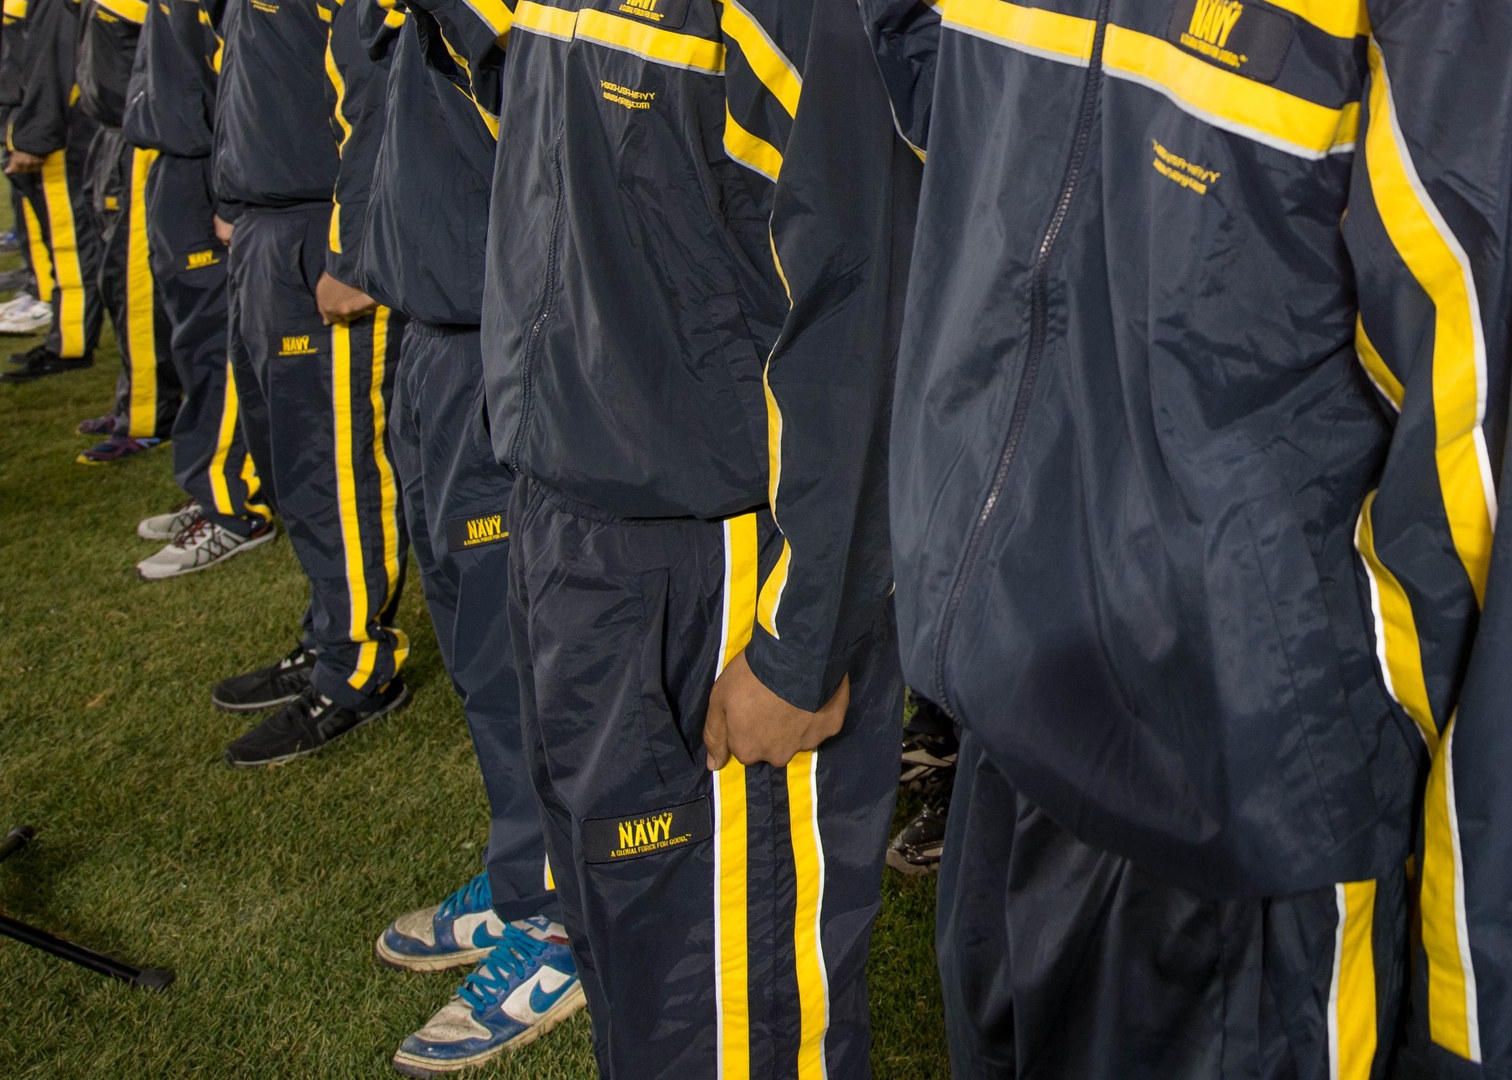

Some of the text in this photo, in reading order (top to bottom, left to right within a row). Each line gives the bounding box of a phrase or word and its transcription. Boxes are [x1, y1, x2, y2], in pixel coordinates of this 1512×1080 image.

[282, 335, 310, 352] NAVY
[466, 515, 502, 539] NAVY
[618, 817, 672, 849] NAVY
[656, 840, 669, 849] FOR
